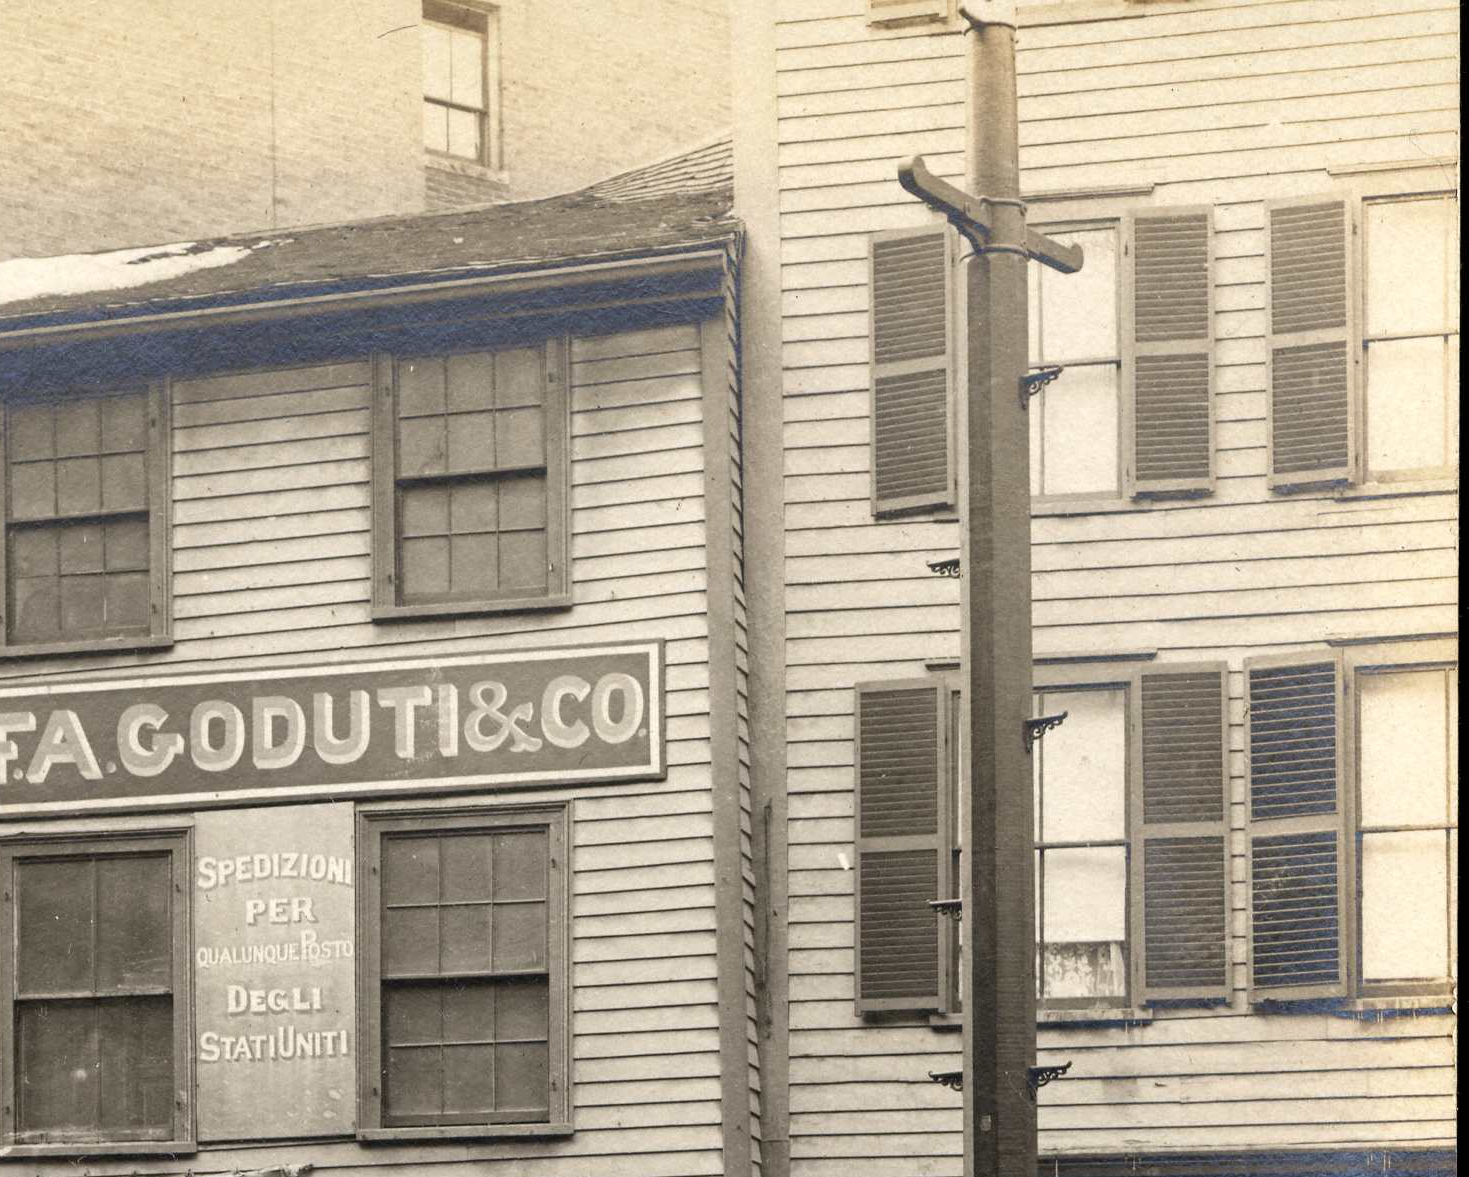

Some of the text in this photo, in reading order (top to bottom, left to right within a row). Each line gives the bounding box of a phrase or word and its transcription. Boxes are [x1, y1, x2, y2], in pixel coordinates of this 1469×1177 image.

[197, 852, 353, 890] SPEDIZIONI
[245, 896, 318, 926] PER
[196, 929, 355, 969] QUALUNQUE POSTO
[226, 984, 322, 1016] DEGLI
[199, 1025, 349, 1063] STATI UNITI
